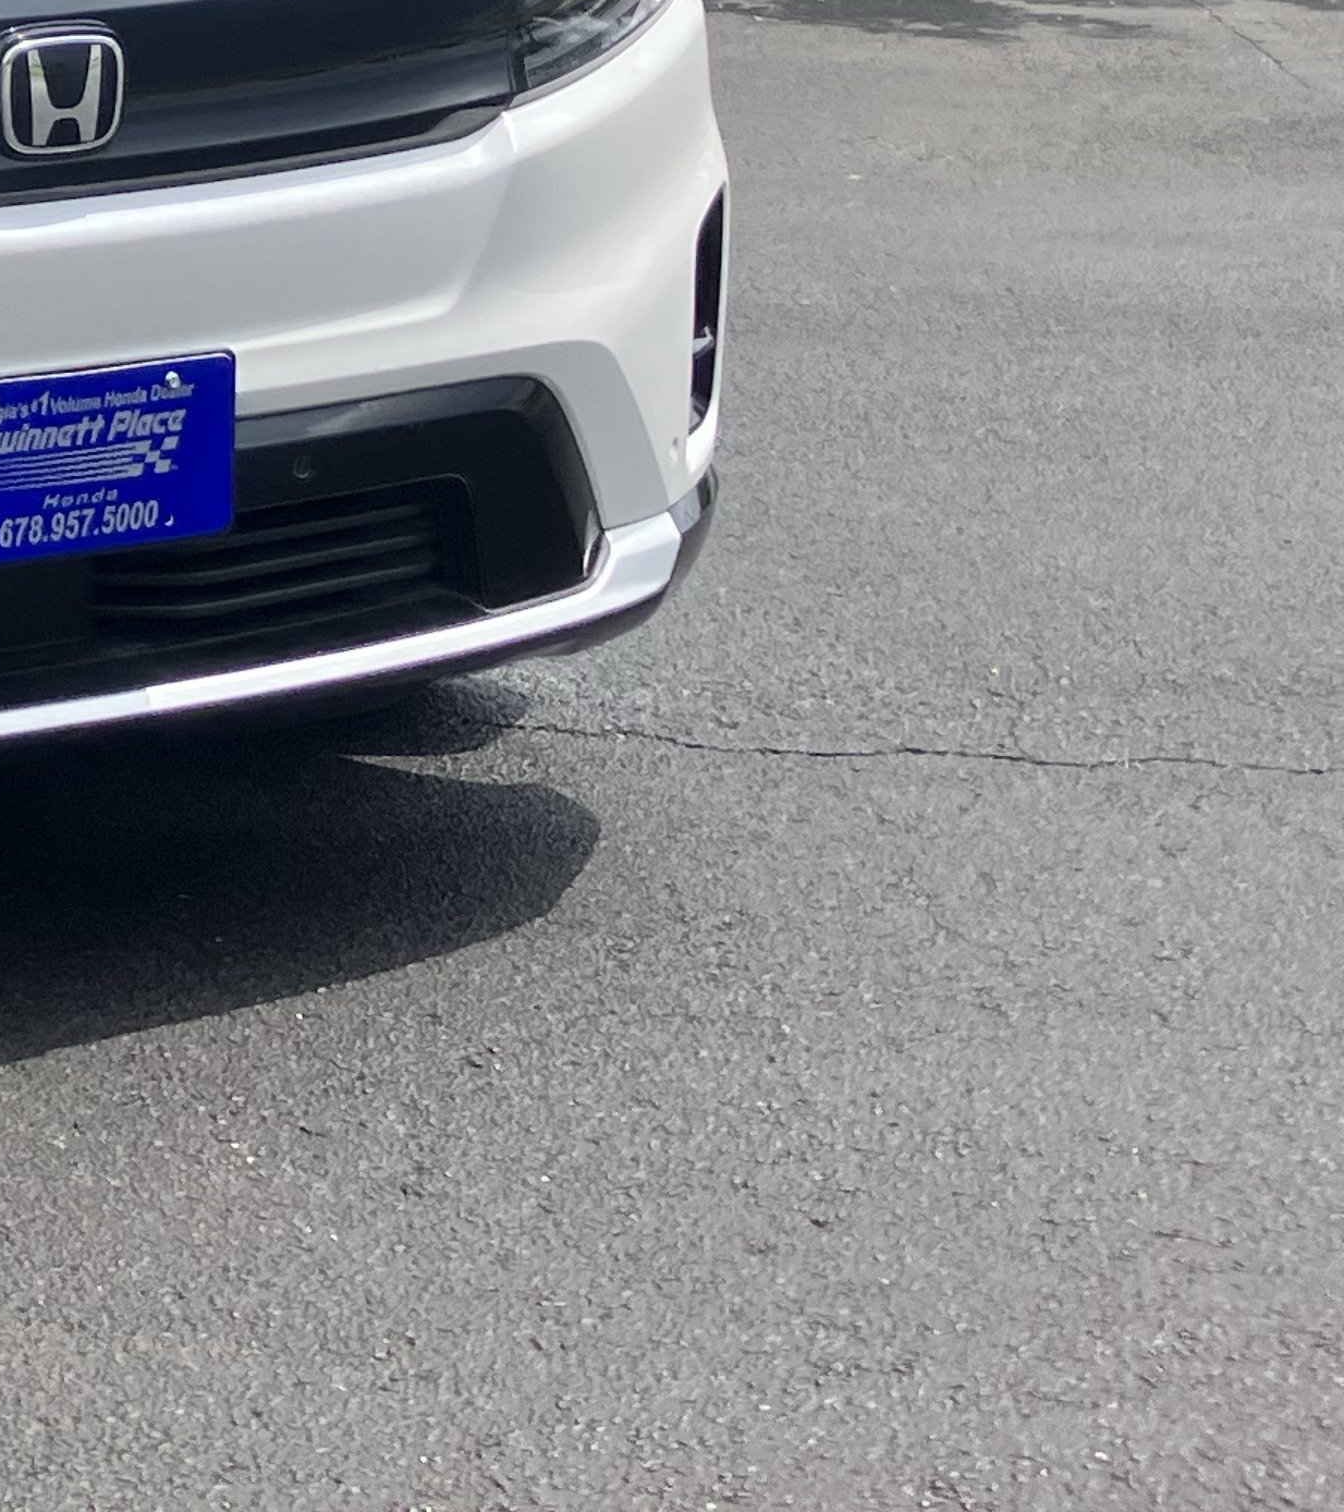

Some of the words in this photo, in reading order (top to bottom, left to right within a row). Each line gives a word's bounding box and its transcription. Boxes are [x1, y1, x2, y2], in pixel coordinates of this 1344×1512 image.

[50, 396, 100, 416] Volume
[104, 386, 147, 408] Honda
[107, 409, 187, 442] Place
[43, 487, 118, 509] Honda
[0, 499, 159, 548] 678.957.5000
